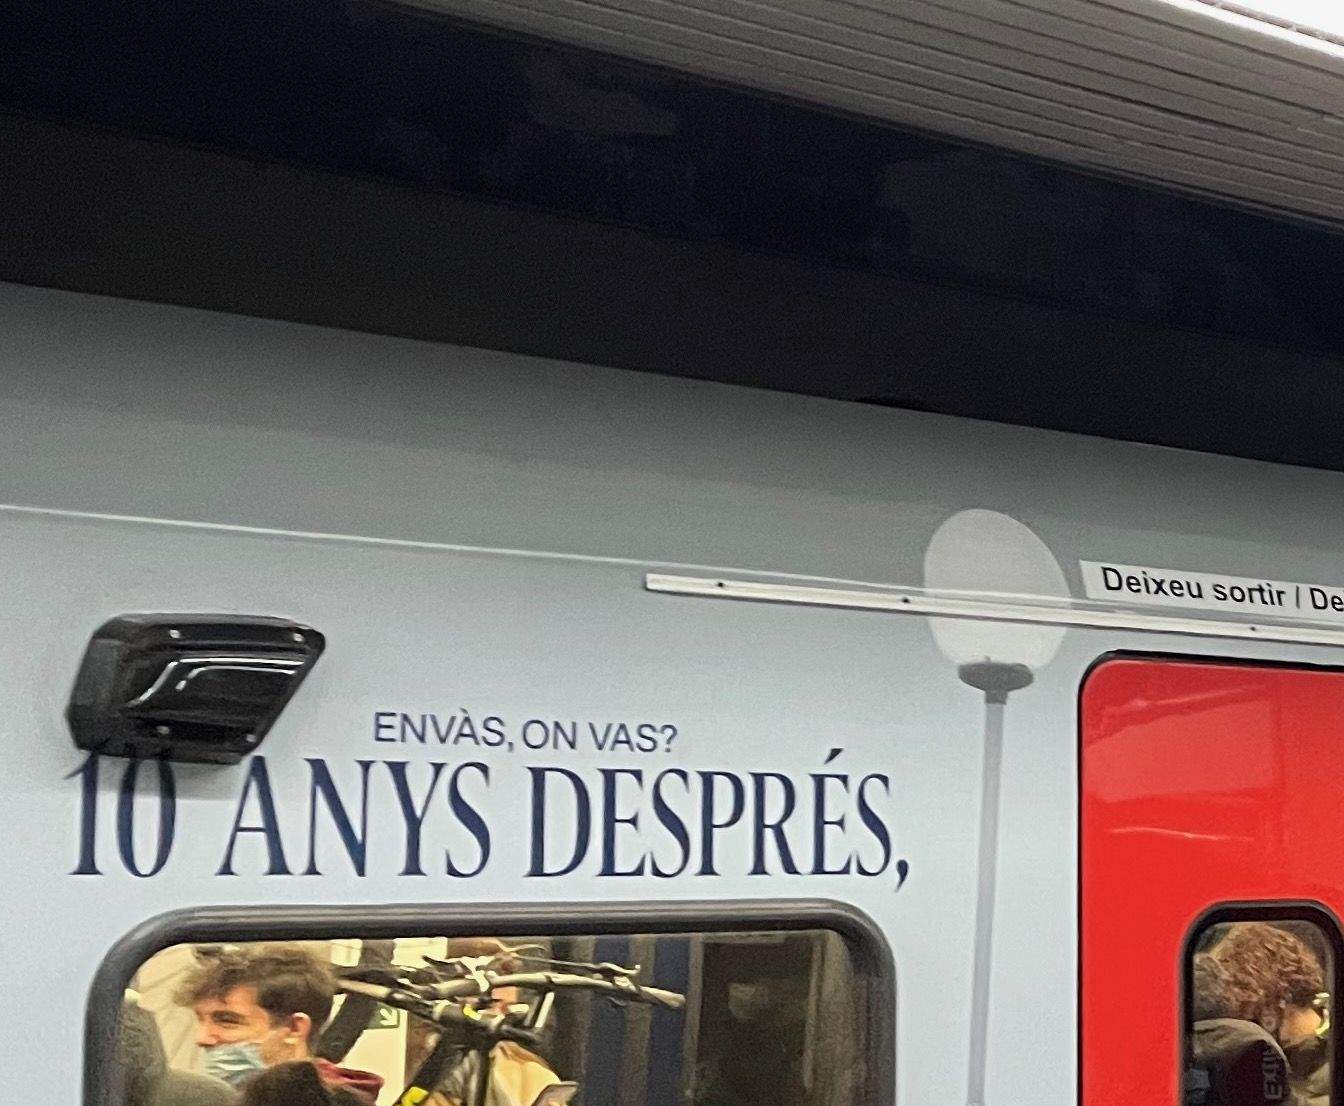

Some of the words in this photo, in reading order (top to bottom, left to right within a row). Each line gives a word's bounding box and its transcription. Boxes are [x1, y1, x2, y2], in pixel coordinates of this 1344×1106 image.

[1101, 566, 1203, 600] Deixeu
[1211, 583, 1286, 607] sortir
[373, 707, 514, 752] ENVÀS,
[522, 719, 577, 751] ON
[588, 721, 679, 753] VAS?
[64, 751, 178, 879] 10
[214, 754, 492, 879] ANYS
[523, 747, 910, 893] DESPRÉS,
